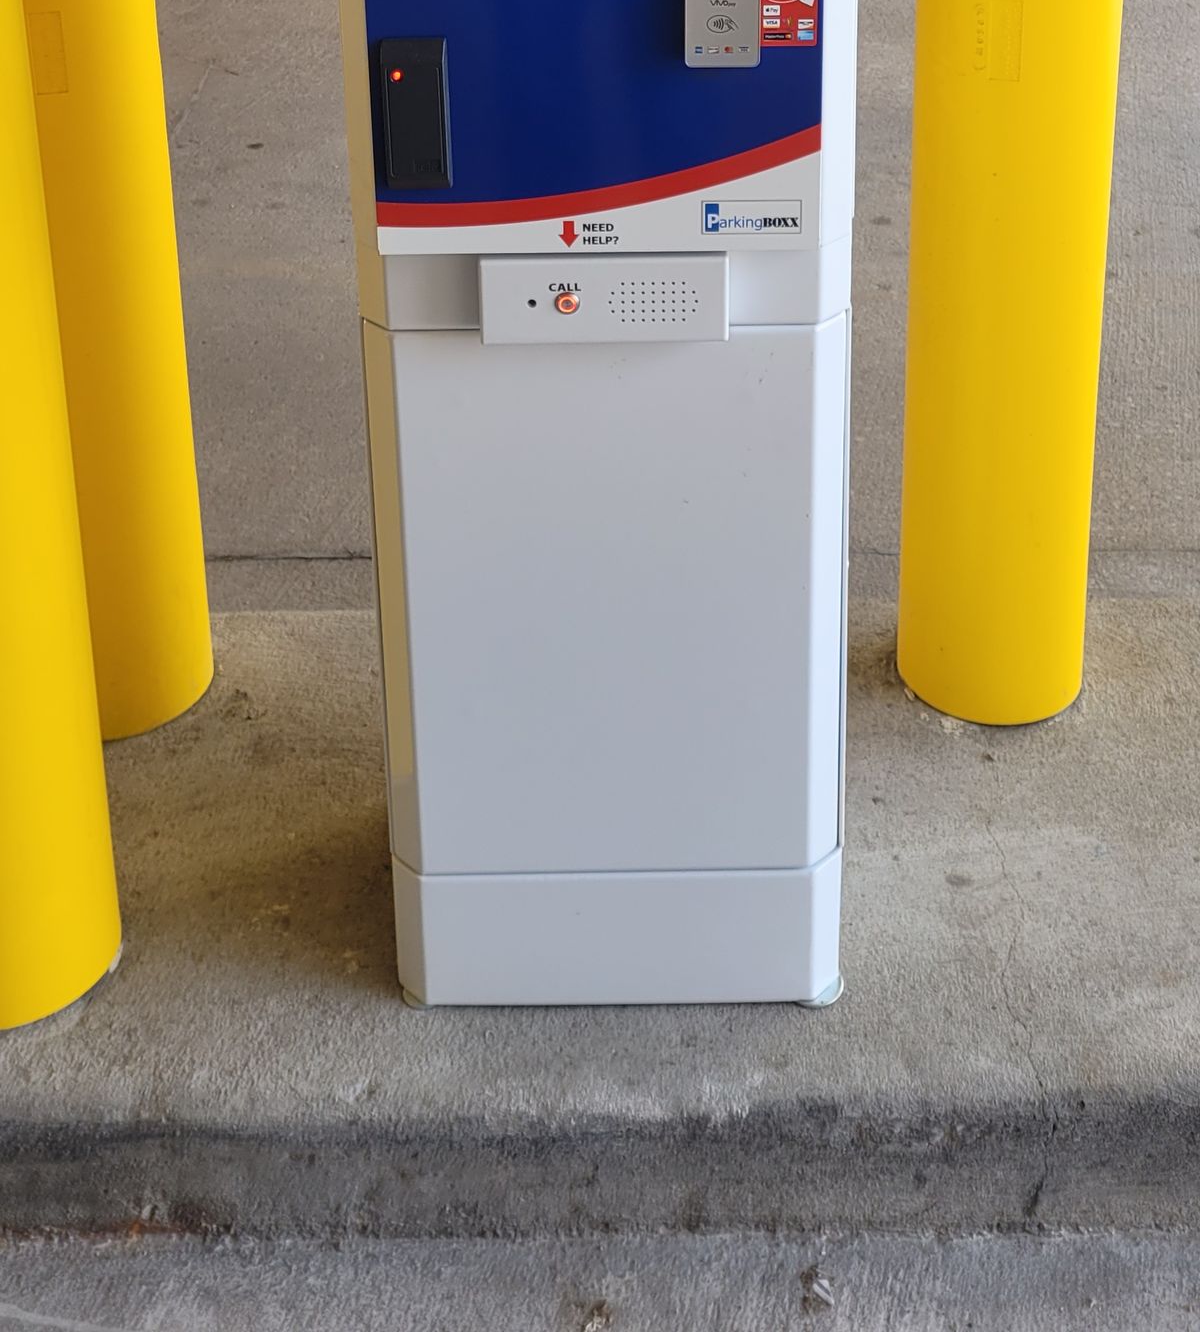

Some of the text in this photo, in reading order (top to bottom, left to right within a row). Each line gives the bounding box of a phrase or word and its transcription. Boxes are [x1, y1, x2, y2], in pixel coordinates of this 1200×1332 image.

[583, 223, 614, 232] NEED
[583, 236, 619, 245] HELP?
[549, 283, 581, 292] CALL
